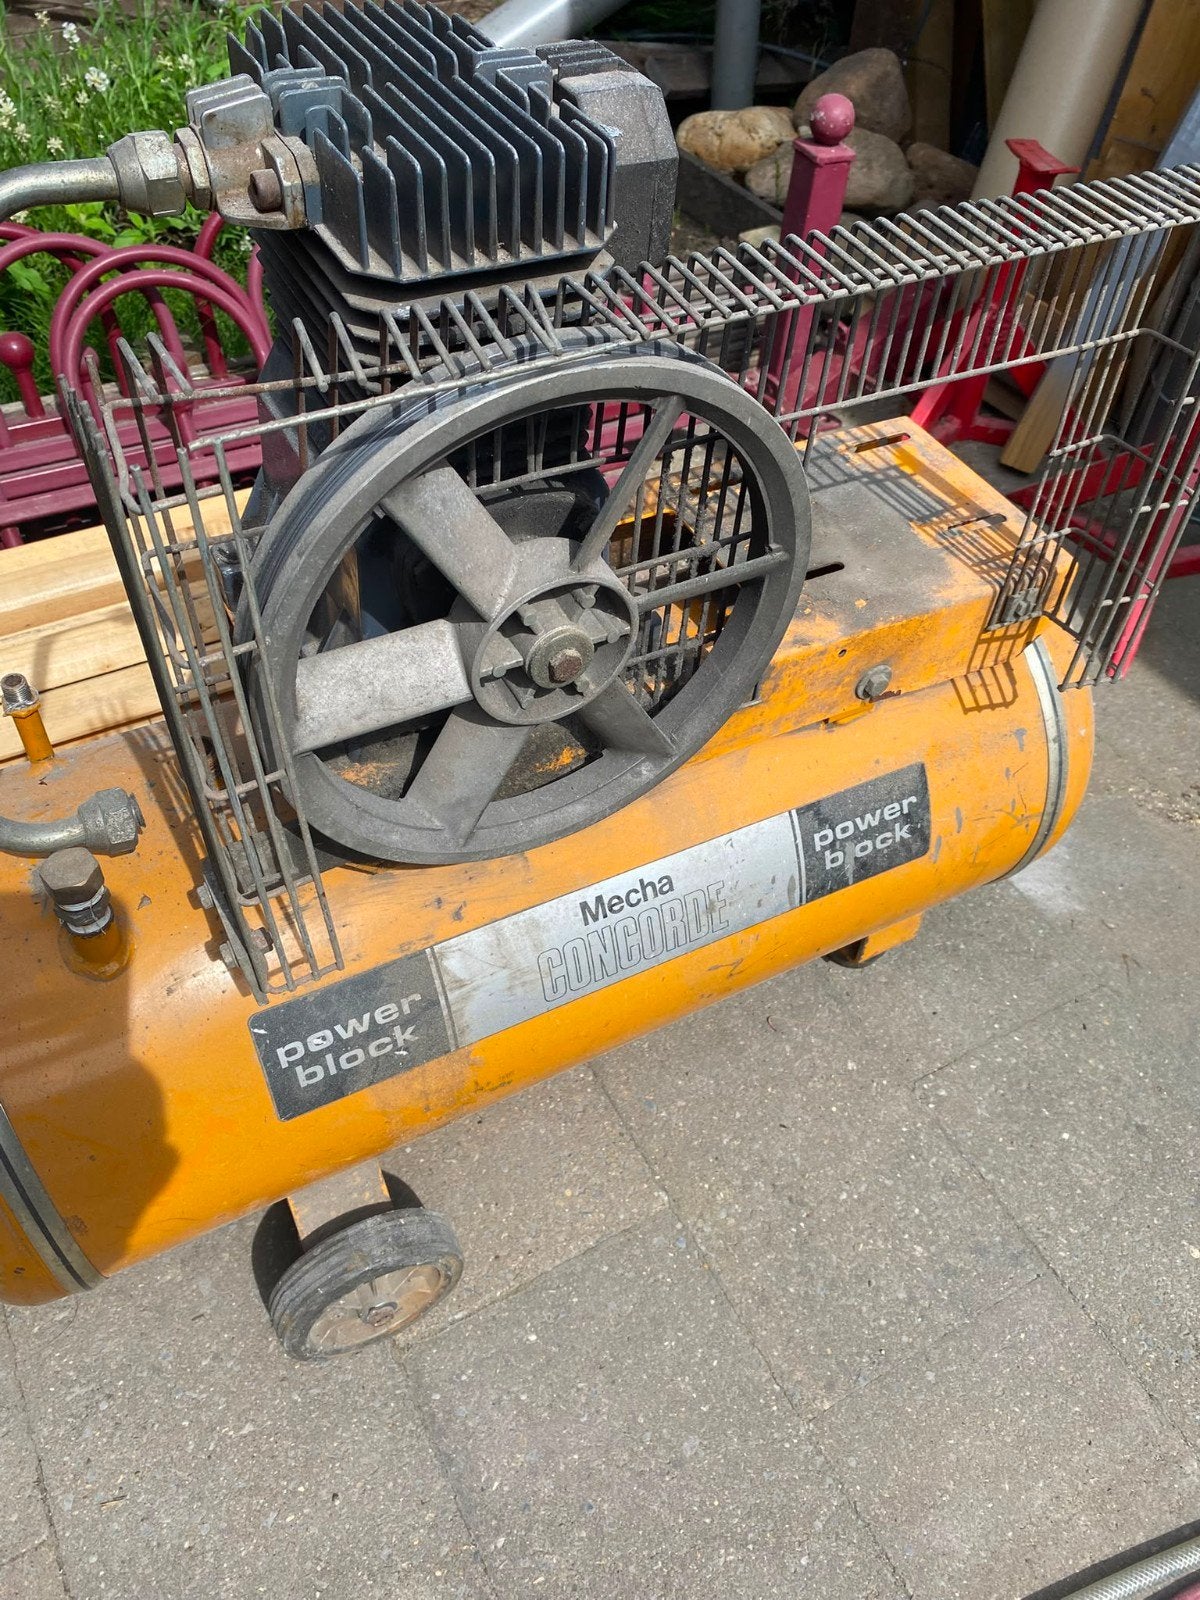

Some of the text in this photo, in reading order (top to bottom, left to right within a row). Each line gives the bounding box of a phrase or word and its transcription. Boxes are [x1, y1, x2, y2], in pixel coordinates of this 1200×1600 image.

[812, 796, 917, 852] power
[824, 822, 912, 870] bock
[579, 874, 675, 926] Mecha
[537, 880, 729, 1002] CONCORDE
[276, 993, 422, 1069] power
[295, 1024, 420, 1088] block
